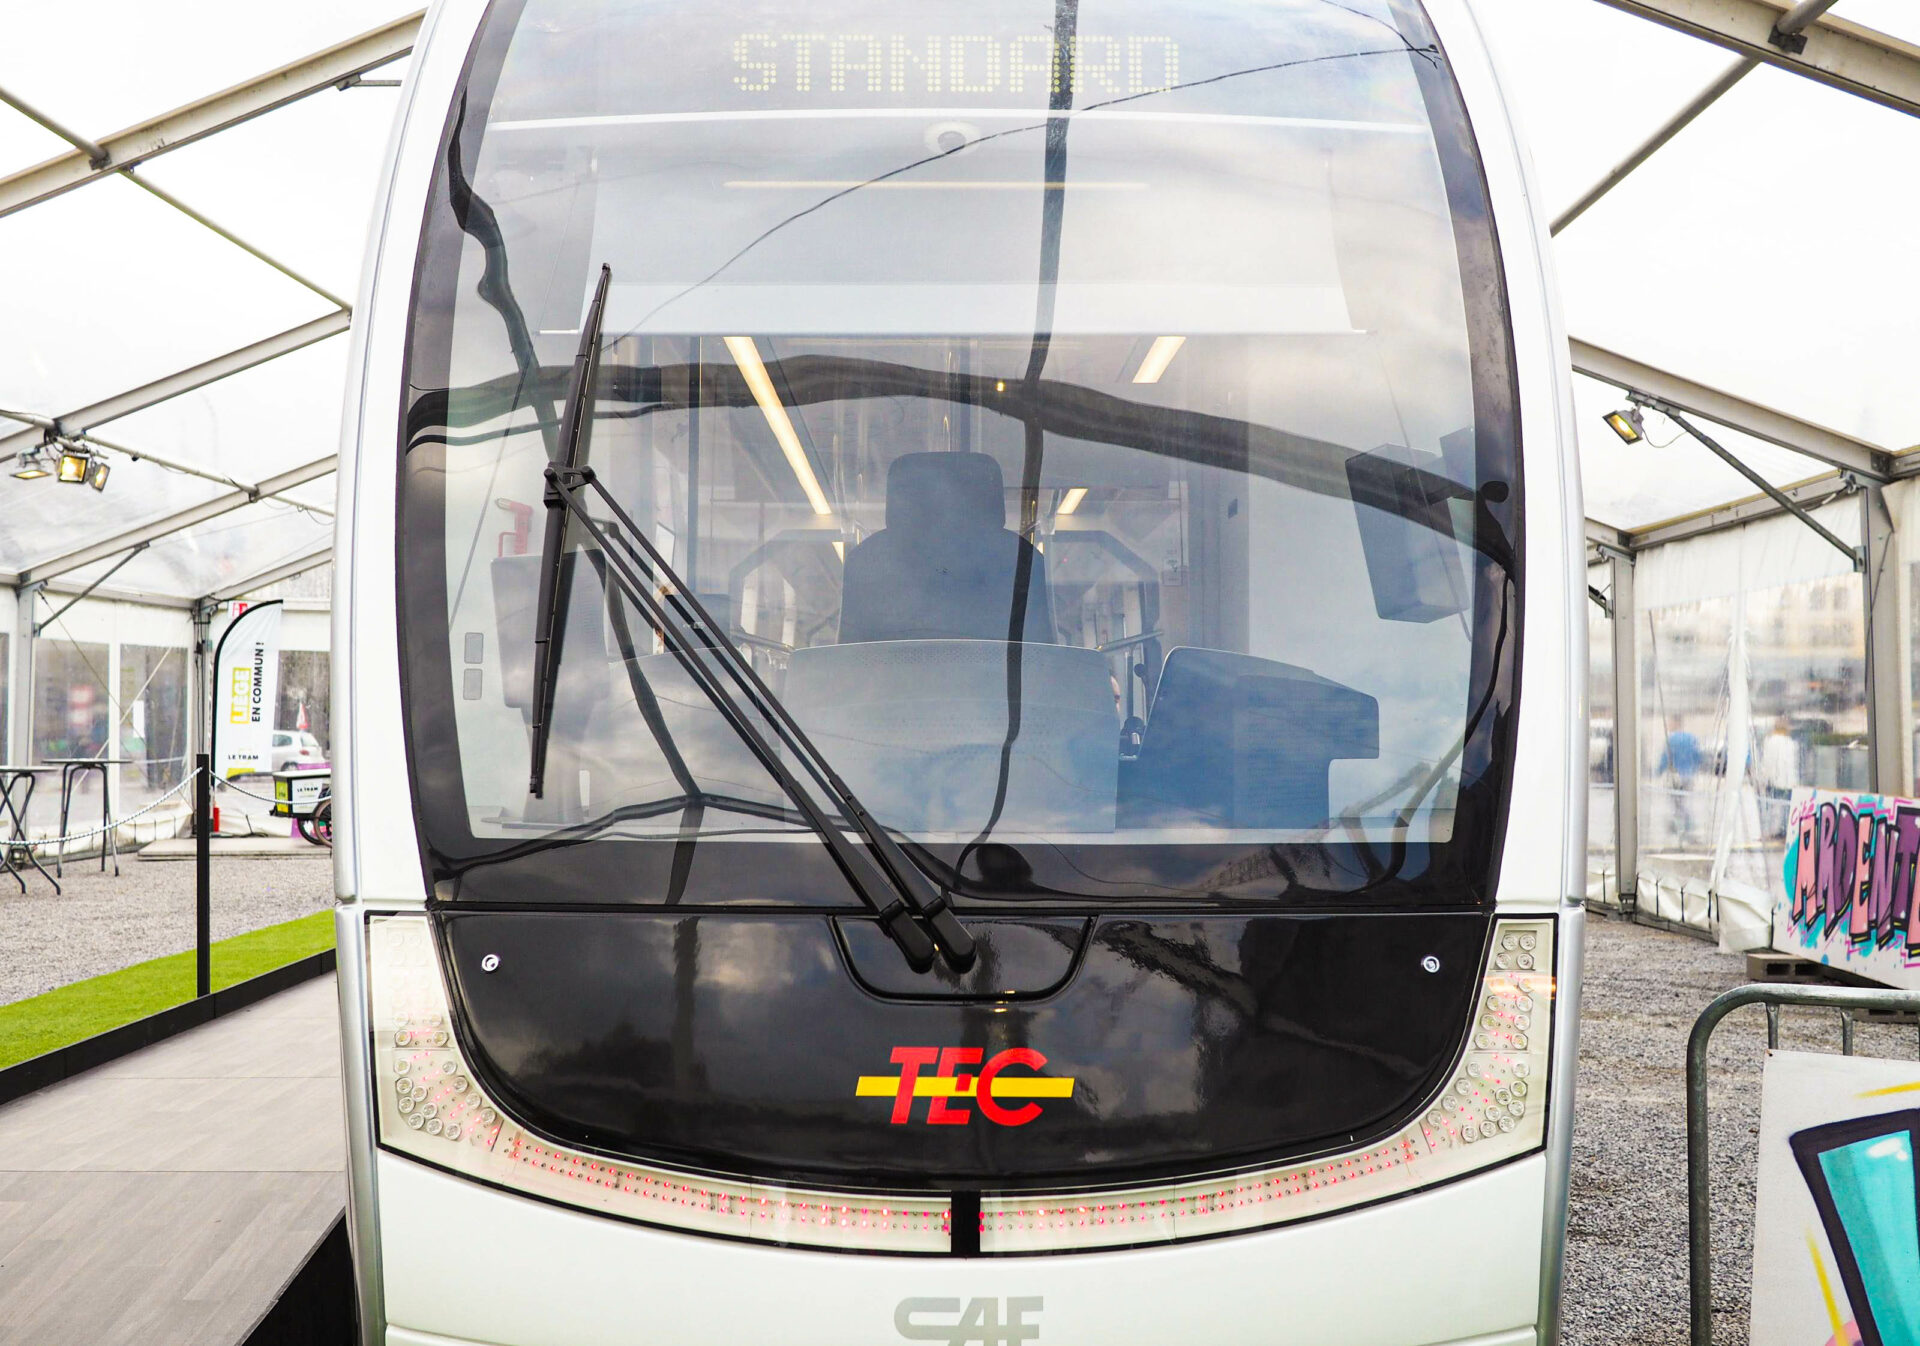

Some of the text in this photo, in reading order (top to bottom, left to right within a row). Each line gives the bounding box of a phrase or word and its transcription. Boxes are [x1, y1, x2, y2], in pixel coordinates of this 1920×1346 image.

[733, 33, 1180, 93] STANDARD
[253, 648, 264, 704] COMMUN
[252, 707, 261, 722] EN
[1791, 800, 1920, 960] ARDENT
[889, 1046, 1049, 1127] TEC
[894, 1296, 1044, 1346] CAF
